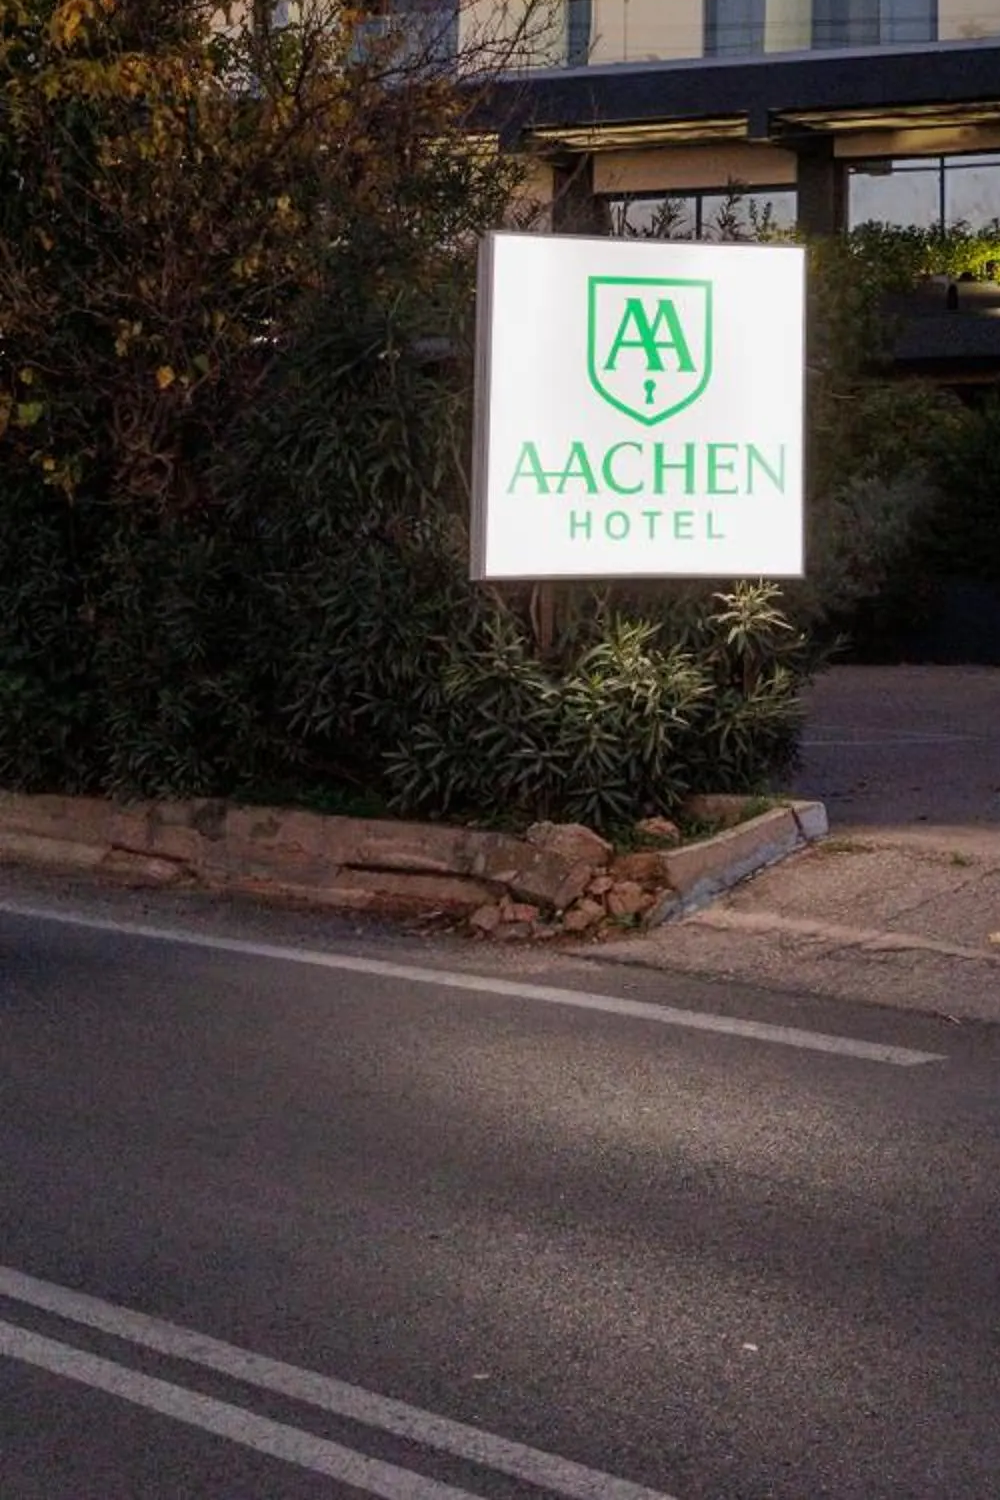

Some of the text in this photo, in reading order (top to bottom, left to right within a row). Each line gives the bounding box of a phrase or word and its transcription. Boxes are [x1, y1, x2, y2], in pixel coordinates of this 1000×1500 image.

[603, 297, 697, 373] AA
[506, 440, 787, 497] AACHEN
[568, 509, 727, 541] HOTEL
